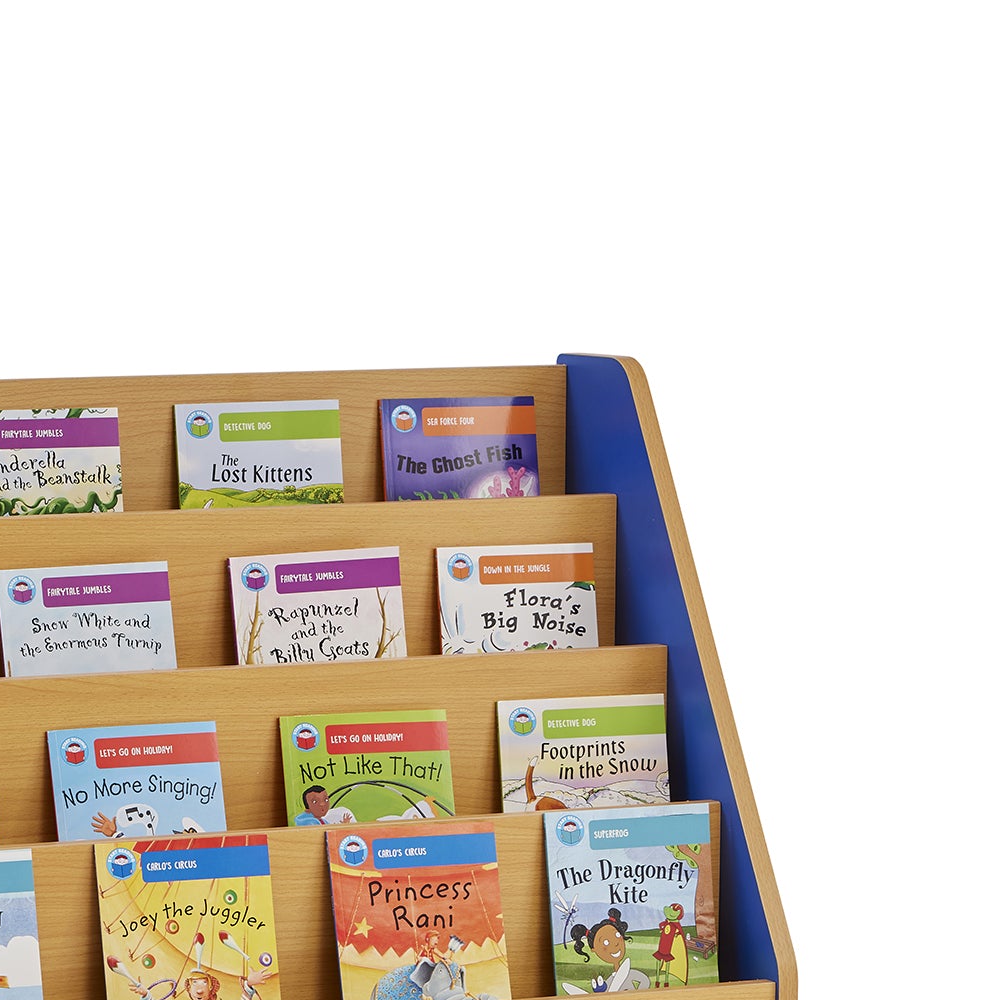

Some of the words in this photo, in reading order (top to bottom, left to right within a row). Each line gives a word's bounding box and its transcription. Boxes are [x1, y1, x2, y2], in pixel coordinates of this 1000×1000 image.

[224, 422, 255, 431] DETECTIVE
[258, 422, 271, 430] DOG
[460, 417, 474, 425] FOUR
[2, 430, 33, 439] FAIRYTALE
[36, 428, 64, 438] JUMBLES
[221, 454, 238, 466] The
[397, 454, 426, 474] The
[431, 450, 482, 474] Ghost
[487, 443, 523, 463] Fish
[14, 477, 32, 491] the
[33, 464, 112, 490] Beanstalk
[212, 464, 247, 483] Lost
[254, 465, 312, 482] Kittens
[281, 573, 312, 583] FAIRYTALE
[314, 571, 344, 581] JUMBLES
[484, 566, 501, 574] DOWN
[503, 565, 510, 573] IN
[513, 565, 525, 573] THE
[528, 564, 550, 573] JUNGLE
[48, 587, 80, 596] FAIRYTALE
[82, 585, 112, 595] JUMBLES
[268, 597, 359, 626] Rapunzel
[504, 588, 581, 615] Flora's
[32, 618, 68, 634] Snow
[72, 611, 121, 630] White
[125, 614, 150, 629] and
[292, 623, 317, 640] and
[322, 620, 344, 636] the
[481, 612, 517, 632] Big
[533, 612, 586, 636] Noise
[20, 643, 41, 658] the
[45, 636, 107, 653] Enormous
[112, 633, 162, 654] Turnip
[319, 638, 369, 658] Goats
[548, 719, 580, 728] DETECTIVE
[582, 718, 596, 727] DOG
[350, 735, 359, 743] GO
[362, 734, 372, 742] ON
[374, 733, 403, 742] HOLIDAY!
[100, 749, 116, 757] LET'S
[119, 748, 129, 756] GO
[131, 748, 141, 756] ON
[143, 746, 173, 755] HOLIDAY!
[540, 740, 626, 764] Footprints
[300, 758, 336, 784] Not
[344, 755, 382, 774] Like
[389, 756, 442, 781] That!
[559, 763, 575, 779] in
[580, 760, 604, 778] the
[608, 758, 657, 775] Snow
[62, 788, 87, 808] No
[94, 778, 142, 799] More
[149, 774, 217, 804] Singing!
[594, 829, 628, 838] SUPERFROG
[108, 850, 118, 862] START
[118, 849, 135, 862] READING
[378, 849, 402, 858] CARLO'S
[405, 848, 426, 856] CIRCUS
[147, 862, 172, 871] CARLO'S
[175, 860, 197, 870] CIRCUS
[557, 867, 592, 890] The
[599, 859, 695, 889] Dragonfly
[368, 880, 472, 907] Princess
[609, 884, 648, 905] Kite
[120, 912, 157, 937] Joey
[163, 901, 194, 918] the
[199, 899, 266, 931] Juggler
[393, 906, 453, 930] Rani
